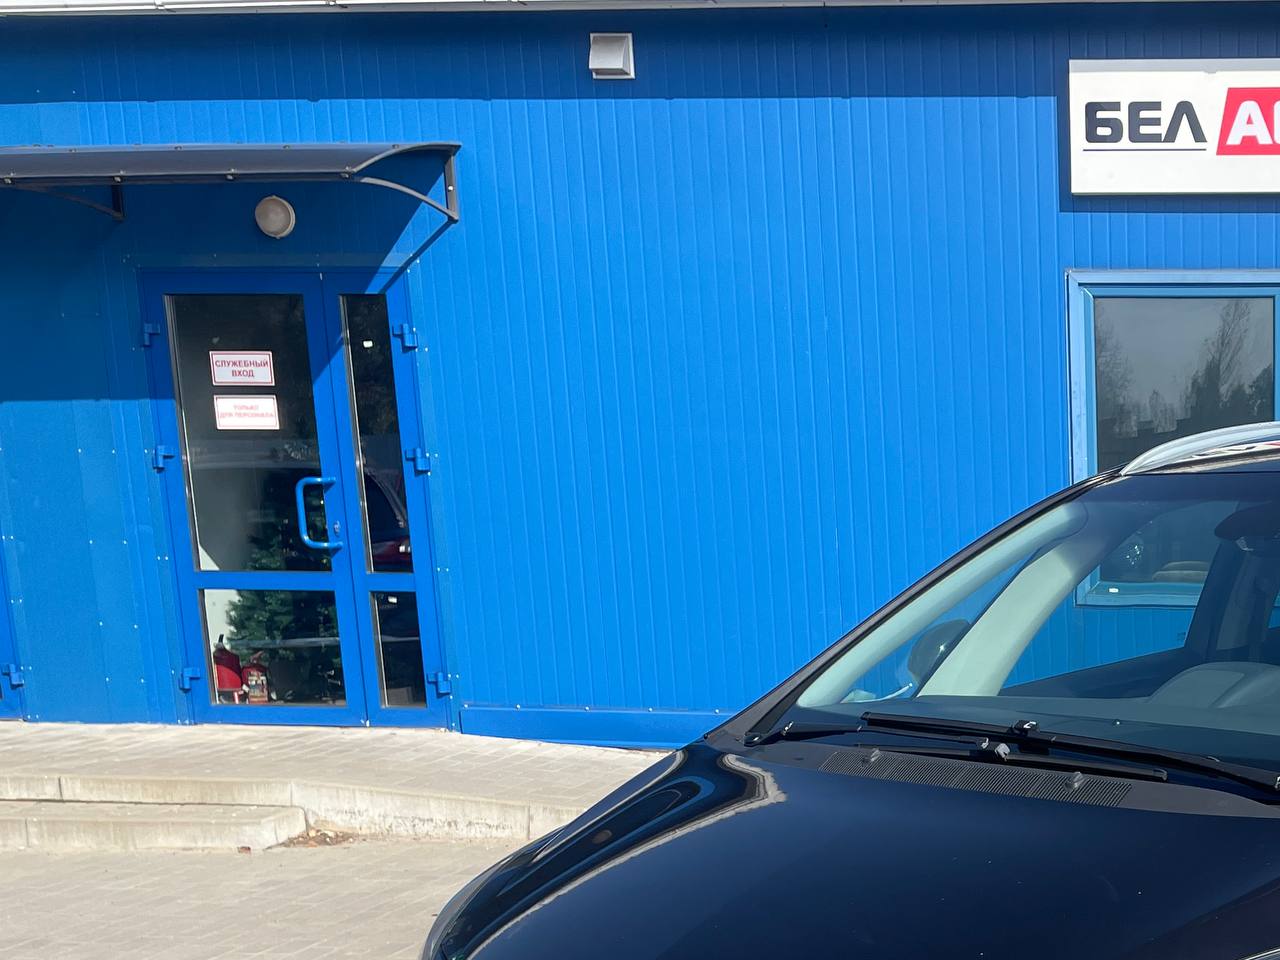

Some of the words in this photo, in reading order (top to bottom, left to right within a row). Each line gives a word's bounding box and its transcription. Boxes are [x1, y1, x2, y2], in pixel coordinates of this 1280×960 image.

[1084, 101, 1207, 143] БЕЛ
[215, 359, 268, 368] СЛУЖЕБНЫЙ
[231, 370, 255, 378] ВХОД
